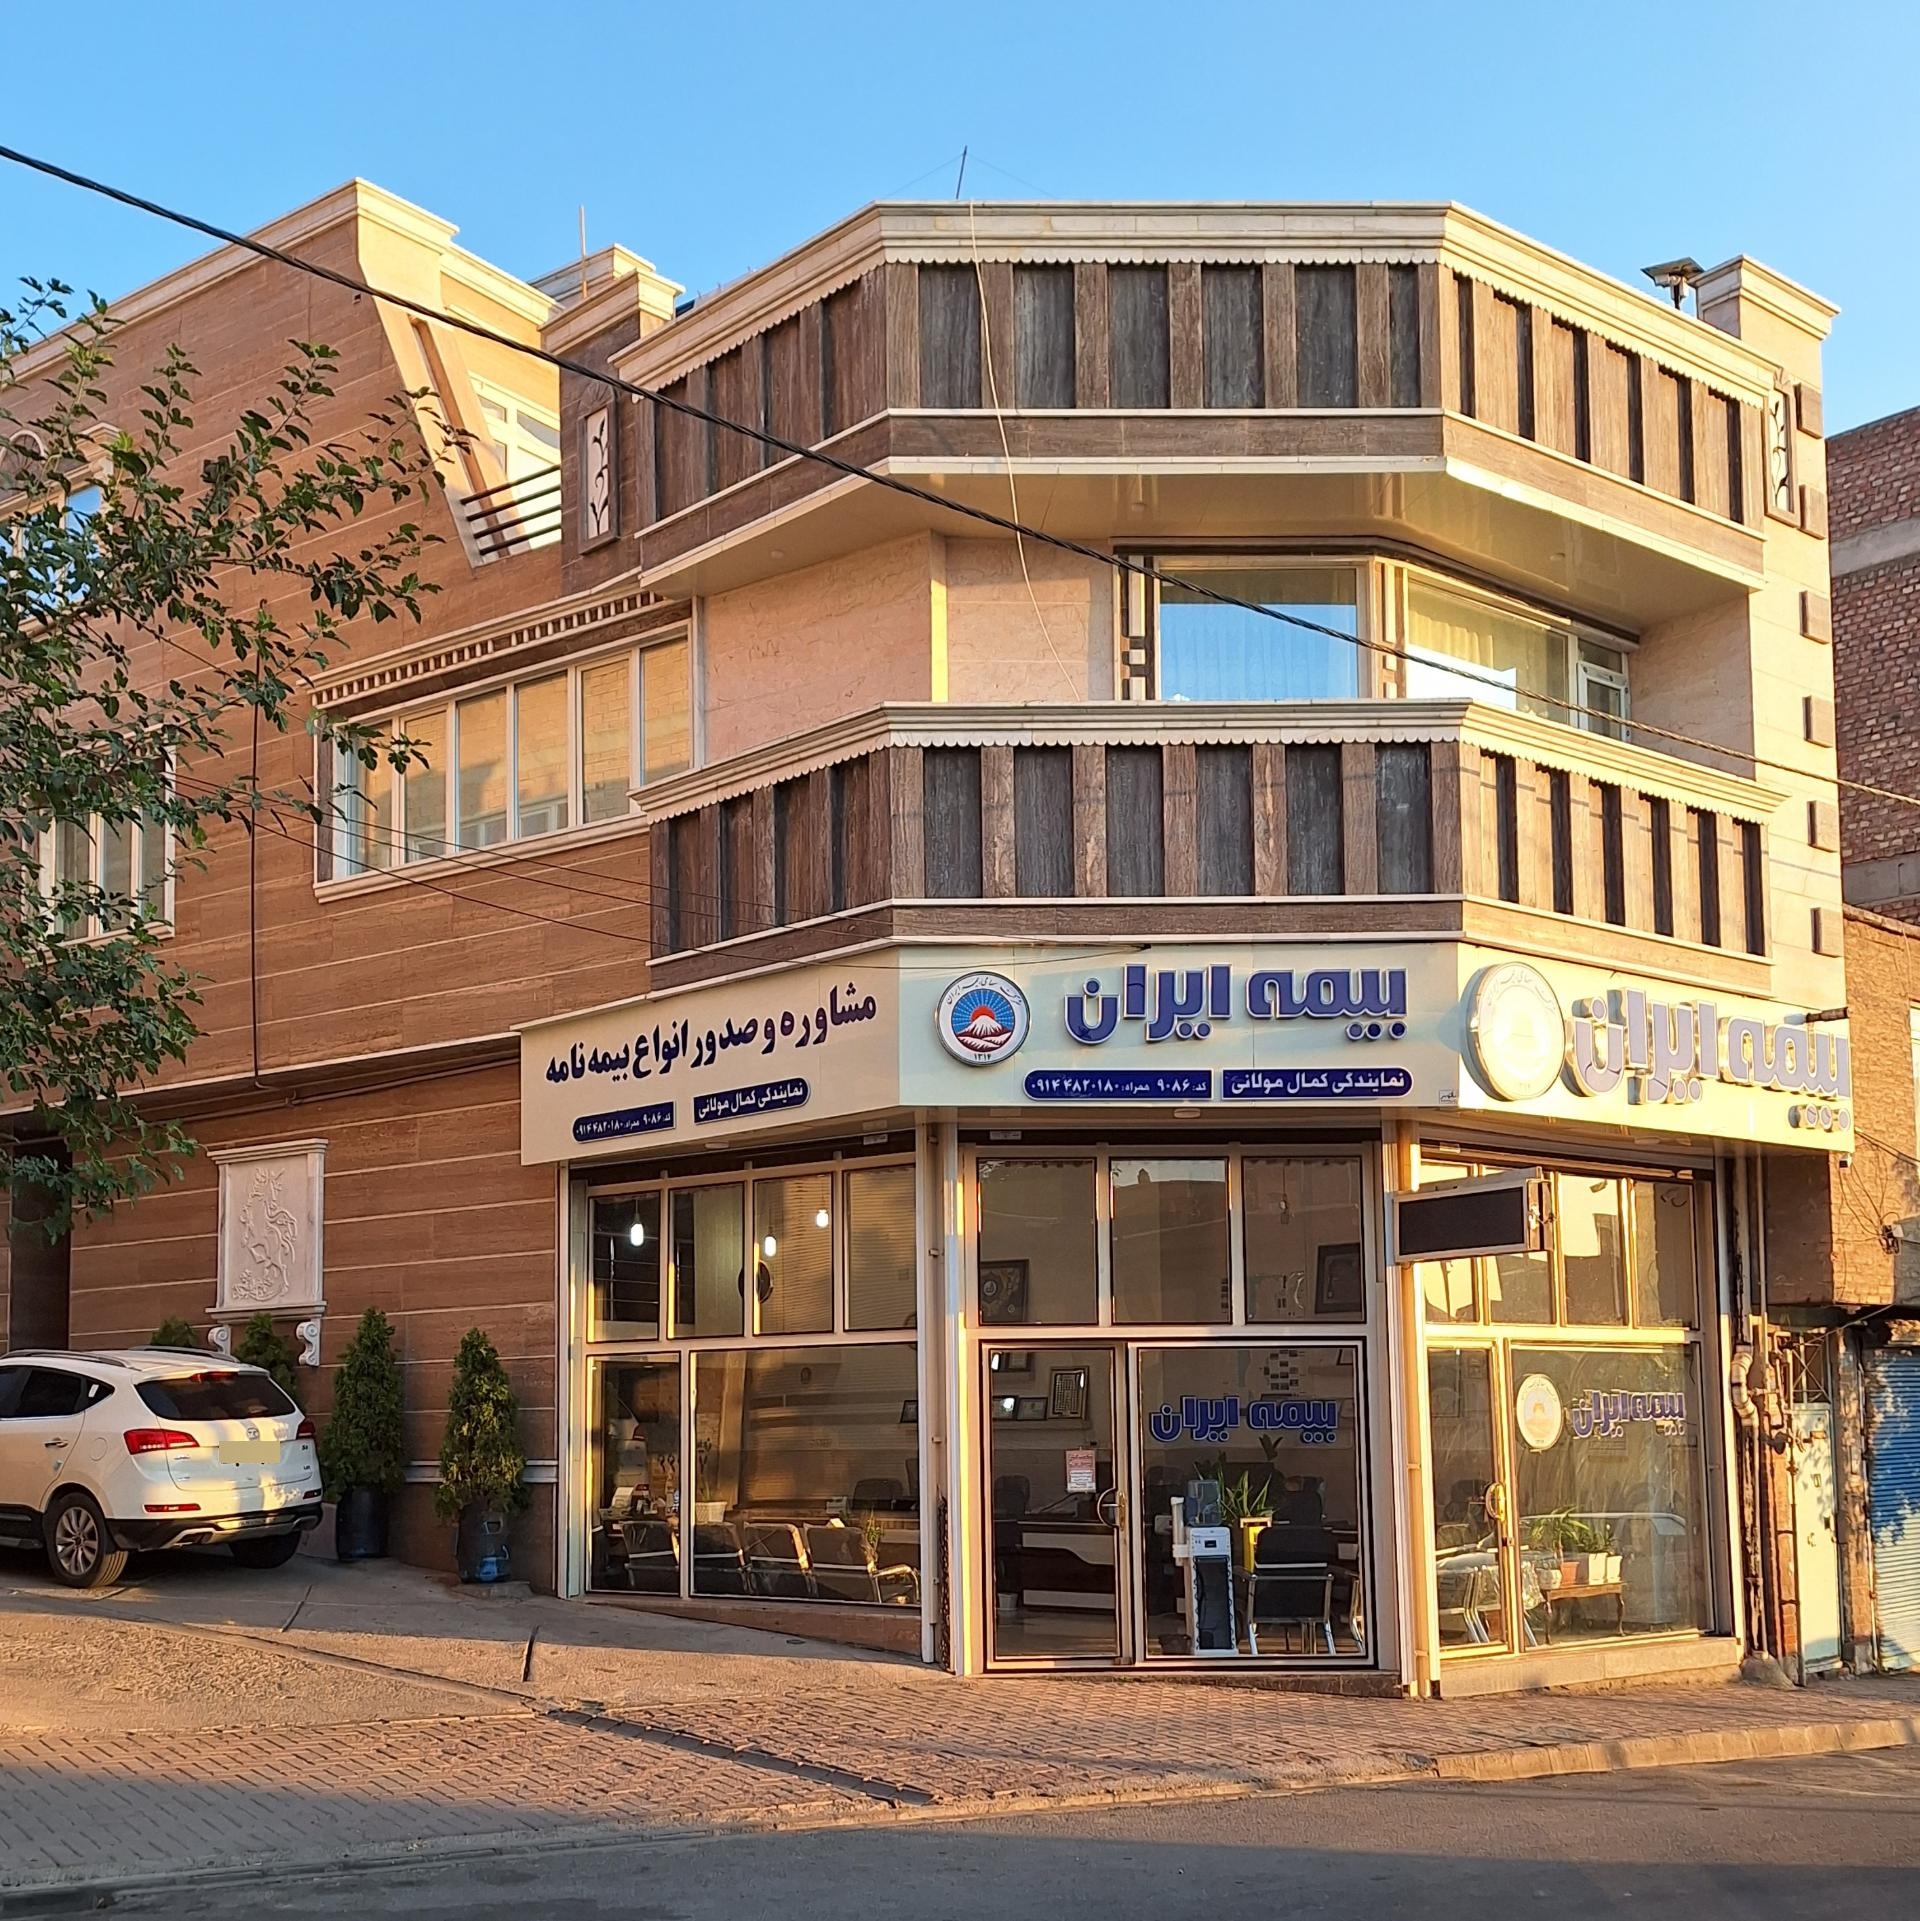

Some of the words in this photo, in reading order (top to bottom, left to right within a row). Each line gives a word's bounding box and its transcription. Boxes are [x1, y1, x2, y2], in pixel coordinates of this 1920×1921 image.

[780, 981, 877, 1049] مشاوره
[1064, 963, 1233, 1045] ایران
[1246, 967, 1409, 1041] بیمه
[632, 1018, 689, 1079] انواع
[690, 1017, 759, 1069] صدور
[760, 1017, 776, 1055] و
[1569, 986, 1720, 1104] ایران
[1157, 1078, 1190, 1092] ۹۰۸۶
[1231, 1072, 1284, 1095] مولانی
[1286, 1071, 1329, 1094] کمال
[1332, 1071, 1405, 1093] نمایندگی
[1723, 1014, 1853, 1132] بیمه
[642, 1111, 662, 1125] ۹۰۸۶
[698, 1096, 729, 1119] مولانی
[730, 1089, 756, 1113] کمال
[1150, 1395, 1241, 1443] ایران
[1250, 1400, 1338, 1444] بیمه
[1571, 1388, 1631, 1439] ایران
[1631, 1391, 1686, 1436] بیمه
